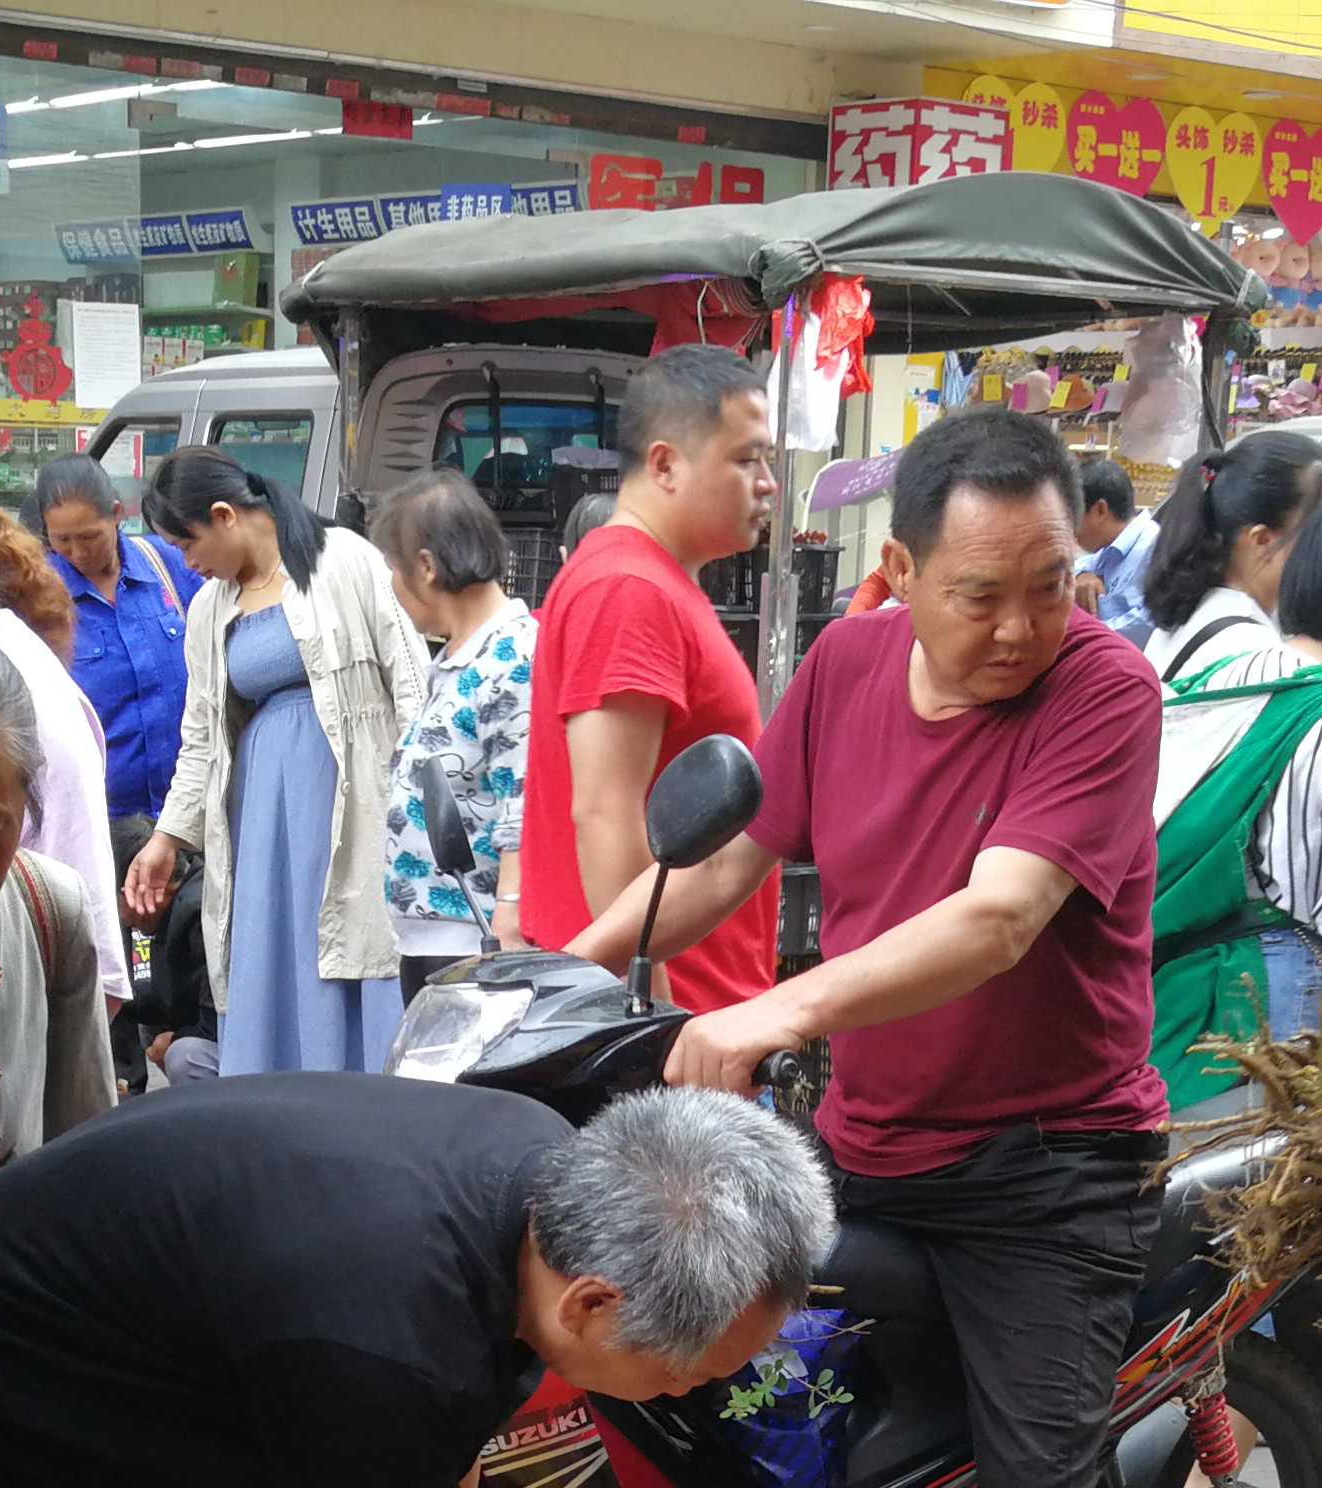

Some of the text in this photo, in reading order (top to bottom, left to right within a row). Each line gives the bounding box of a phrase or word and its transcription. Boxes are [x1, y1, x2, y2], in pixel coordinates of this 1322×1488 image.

[1021, 101, 1059, 130] 秒杀
[832, 105, 917, 190] 药
[918, 105, 1007, 184] 药
[1074, 125, 1163, 180] 买一送一
[1222, 129, 1255, 156] 秒杀
[298, 204, 378, 242] 计生用品
[446, 194, 504, 221] 非药品区
[479, 1407, 588, 1456] SUZUKI
